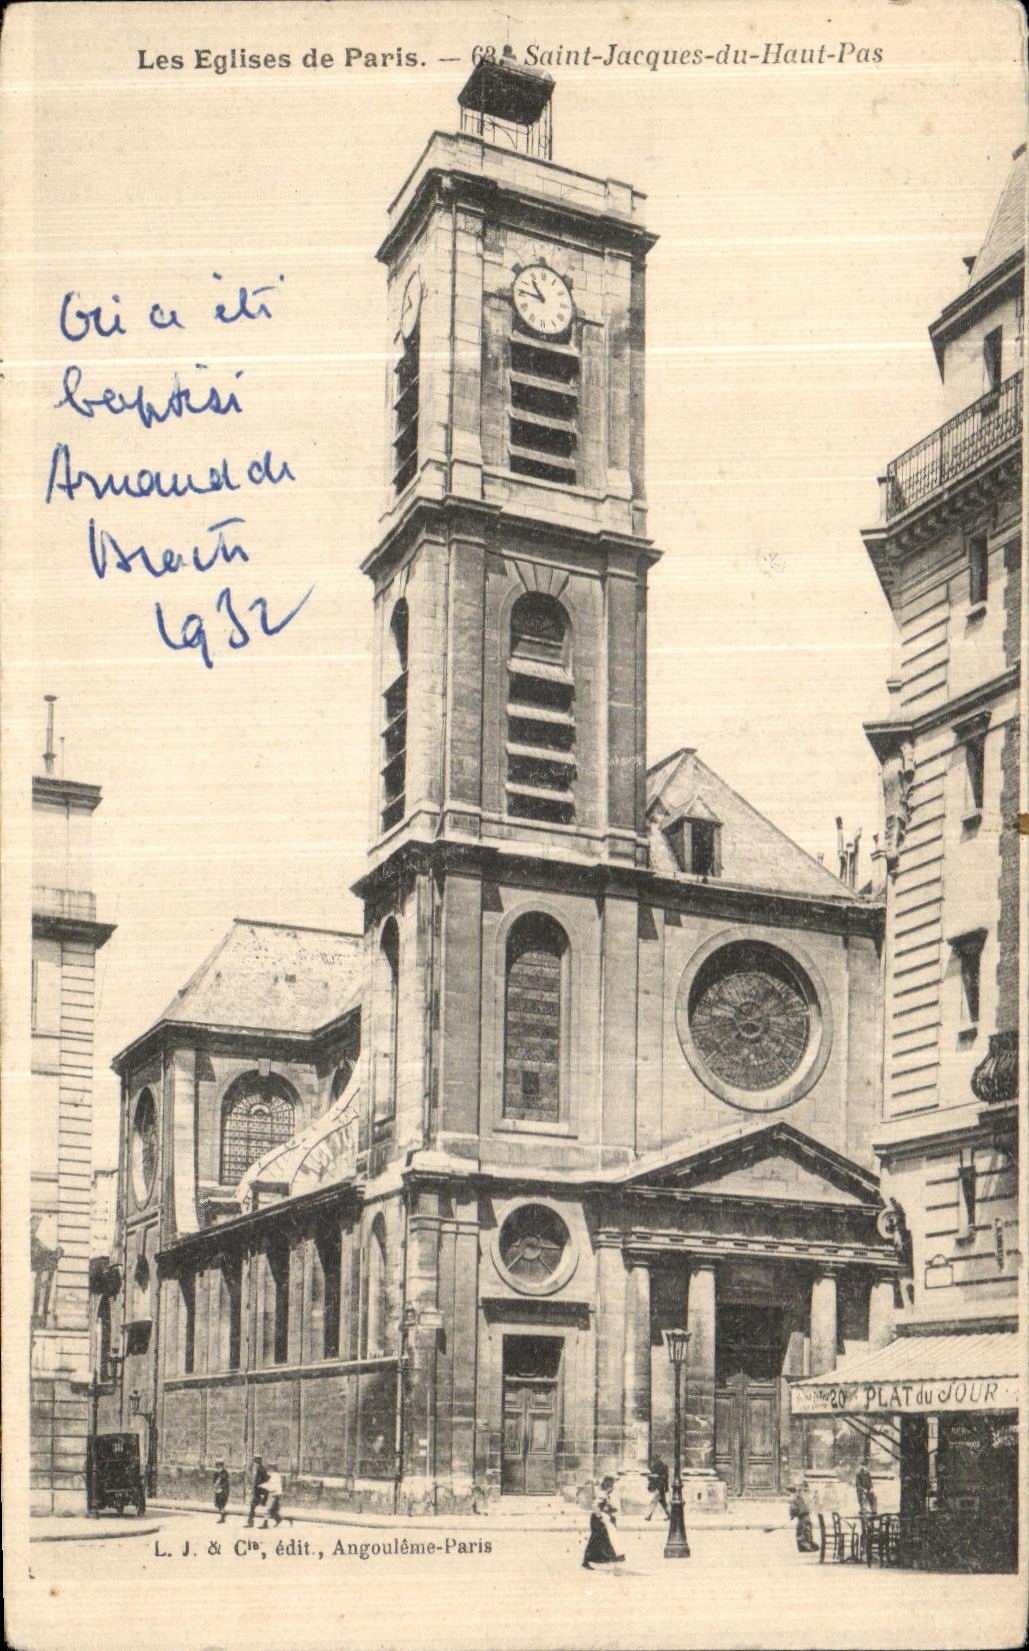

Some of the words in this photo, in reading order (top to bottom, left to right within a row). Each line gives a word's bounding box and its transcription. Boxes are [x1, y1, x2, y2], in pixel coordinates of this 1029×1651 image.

[149, 303, 186, 330] a
[863, 1384, 911, 1410] PLAT
[916, 1384, 933, 1406] du
[937, 1380, 998, 1404] JOUR
